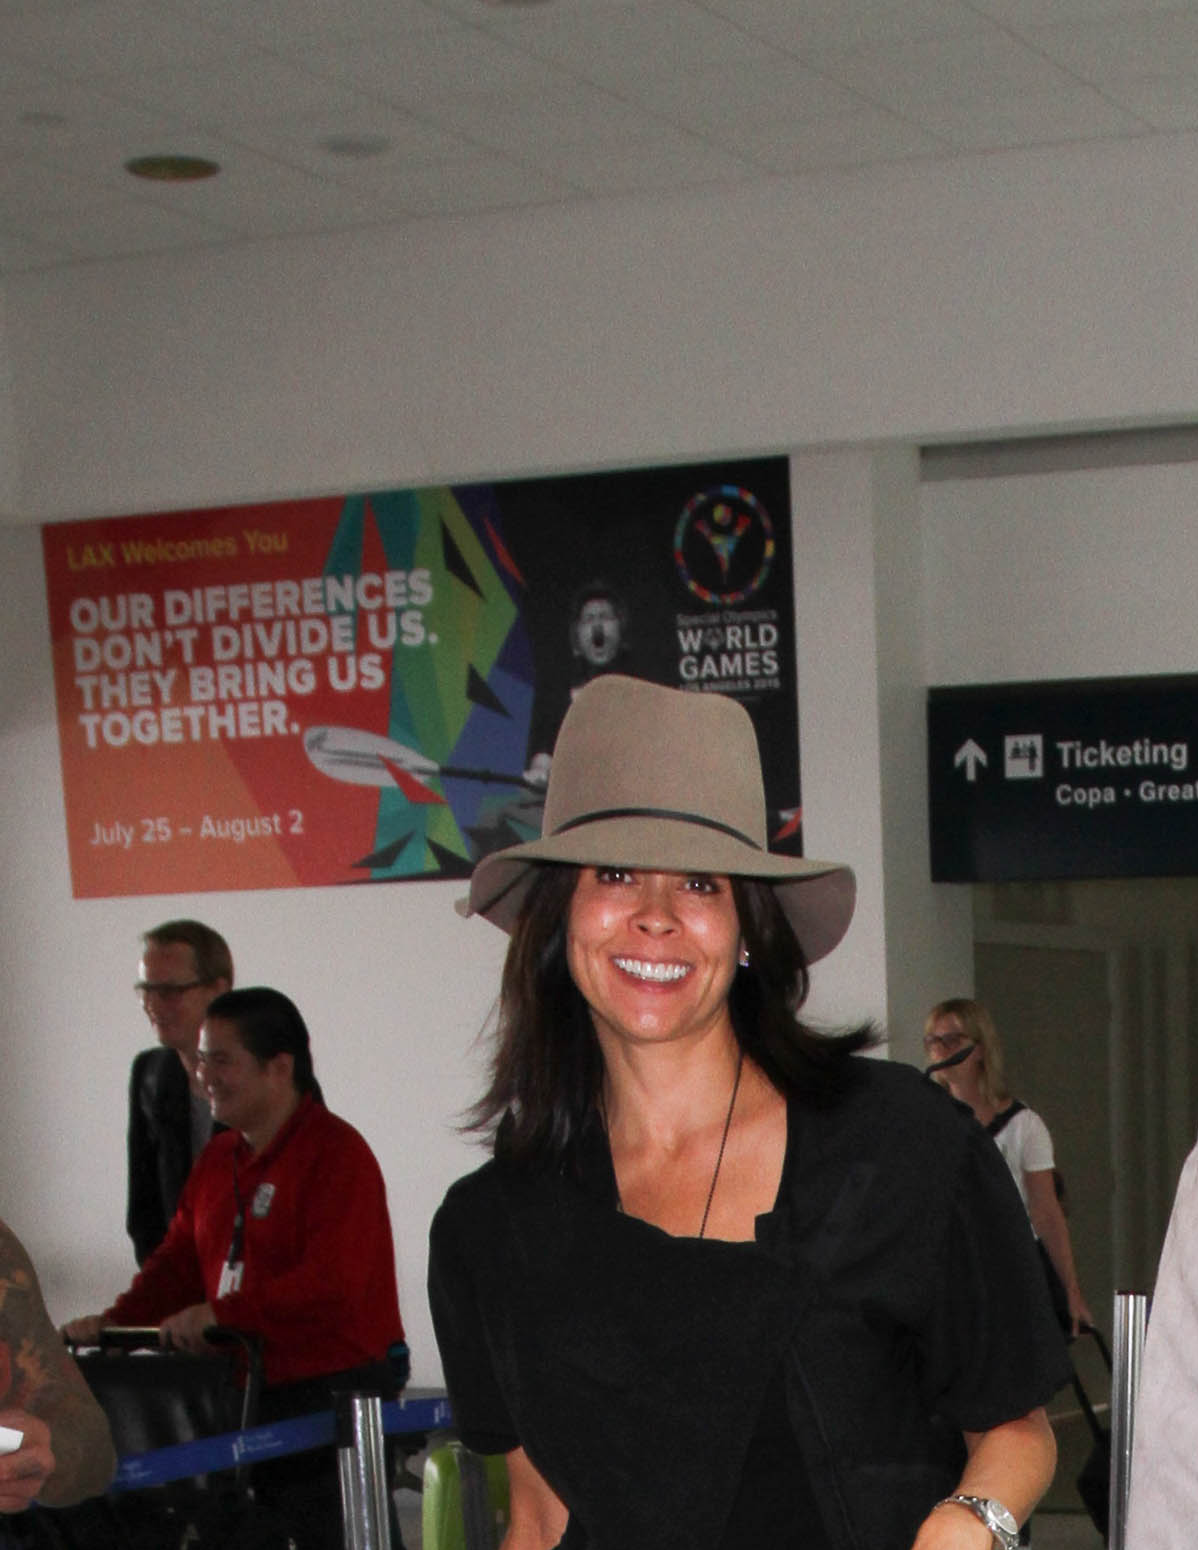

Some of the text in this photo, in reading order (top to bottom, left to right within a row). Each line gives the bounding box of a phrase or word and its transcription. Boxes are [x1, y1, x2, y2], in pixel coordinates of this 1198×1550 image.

[67, 528, 288, 571] LAX Welcomes You
[70, 568, 433, 633] OUR DIFFERENCES
[73, 609, 438, 674] DON'T DIVIDE US.
[75, 652, 385, 710] THEY BRING US
[679, 650, 780, 680] GAMES
[79, 700, 300, 748] TOGETHER.
[1056, 738, 1188, 771] Ticketing
[1055, 783, 1116, 809] Copa
[91, 822, 134, 849] July
[140, 816, 173, 843] 25
[200, 814, 282, 844] August
[288, 808, 304, 835] 2
